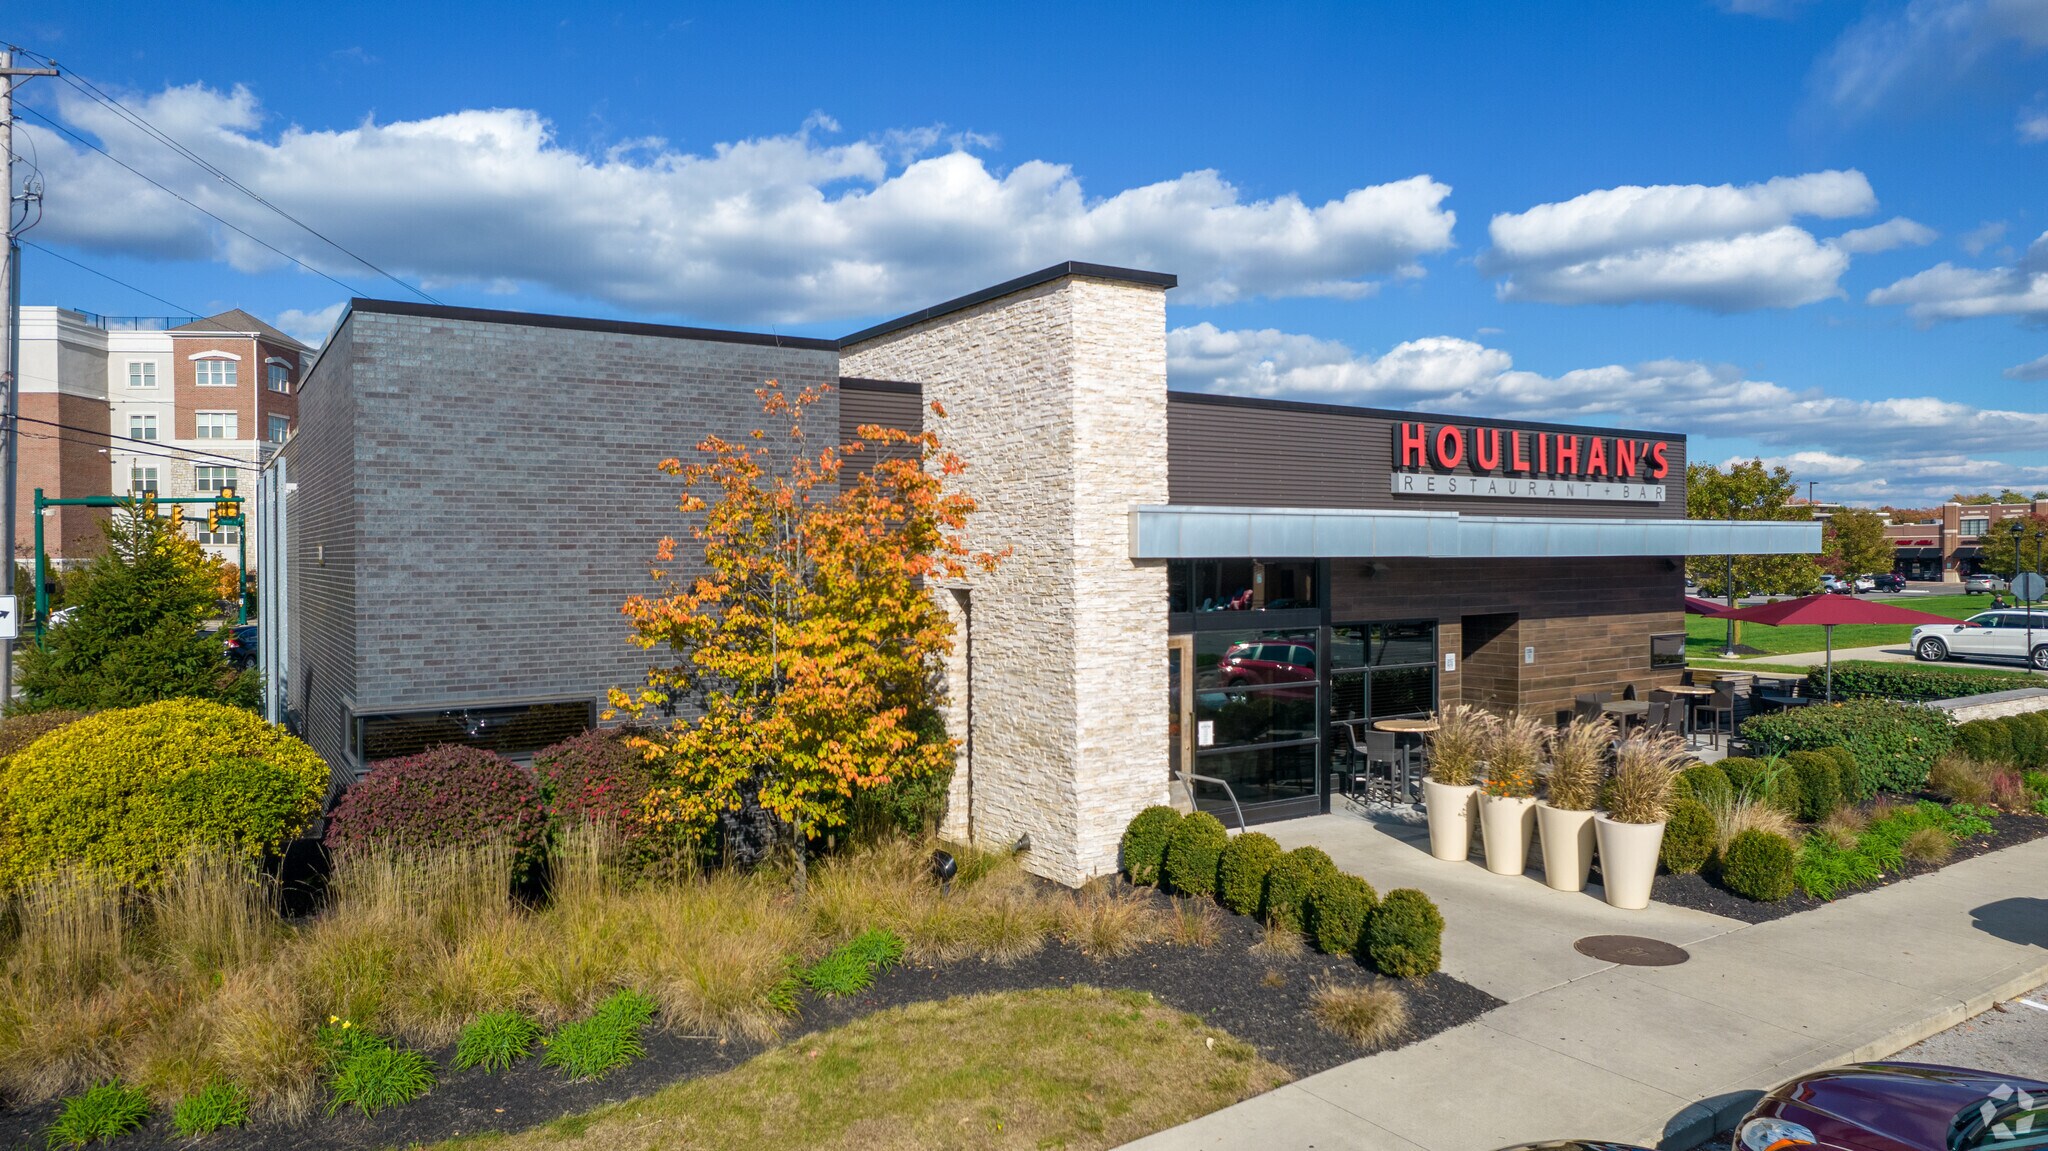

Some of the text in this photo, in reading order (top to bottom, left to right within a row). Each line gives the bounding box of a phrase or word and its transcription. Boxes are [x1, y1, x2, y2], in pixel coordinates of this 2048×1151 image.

[1400, 422, 1669, 479] HOULIHAN'S
[1404, 475, 1592, 498] RESTAURANT
[1623, 485, 1663, 500] BAR
